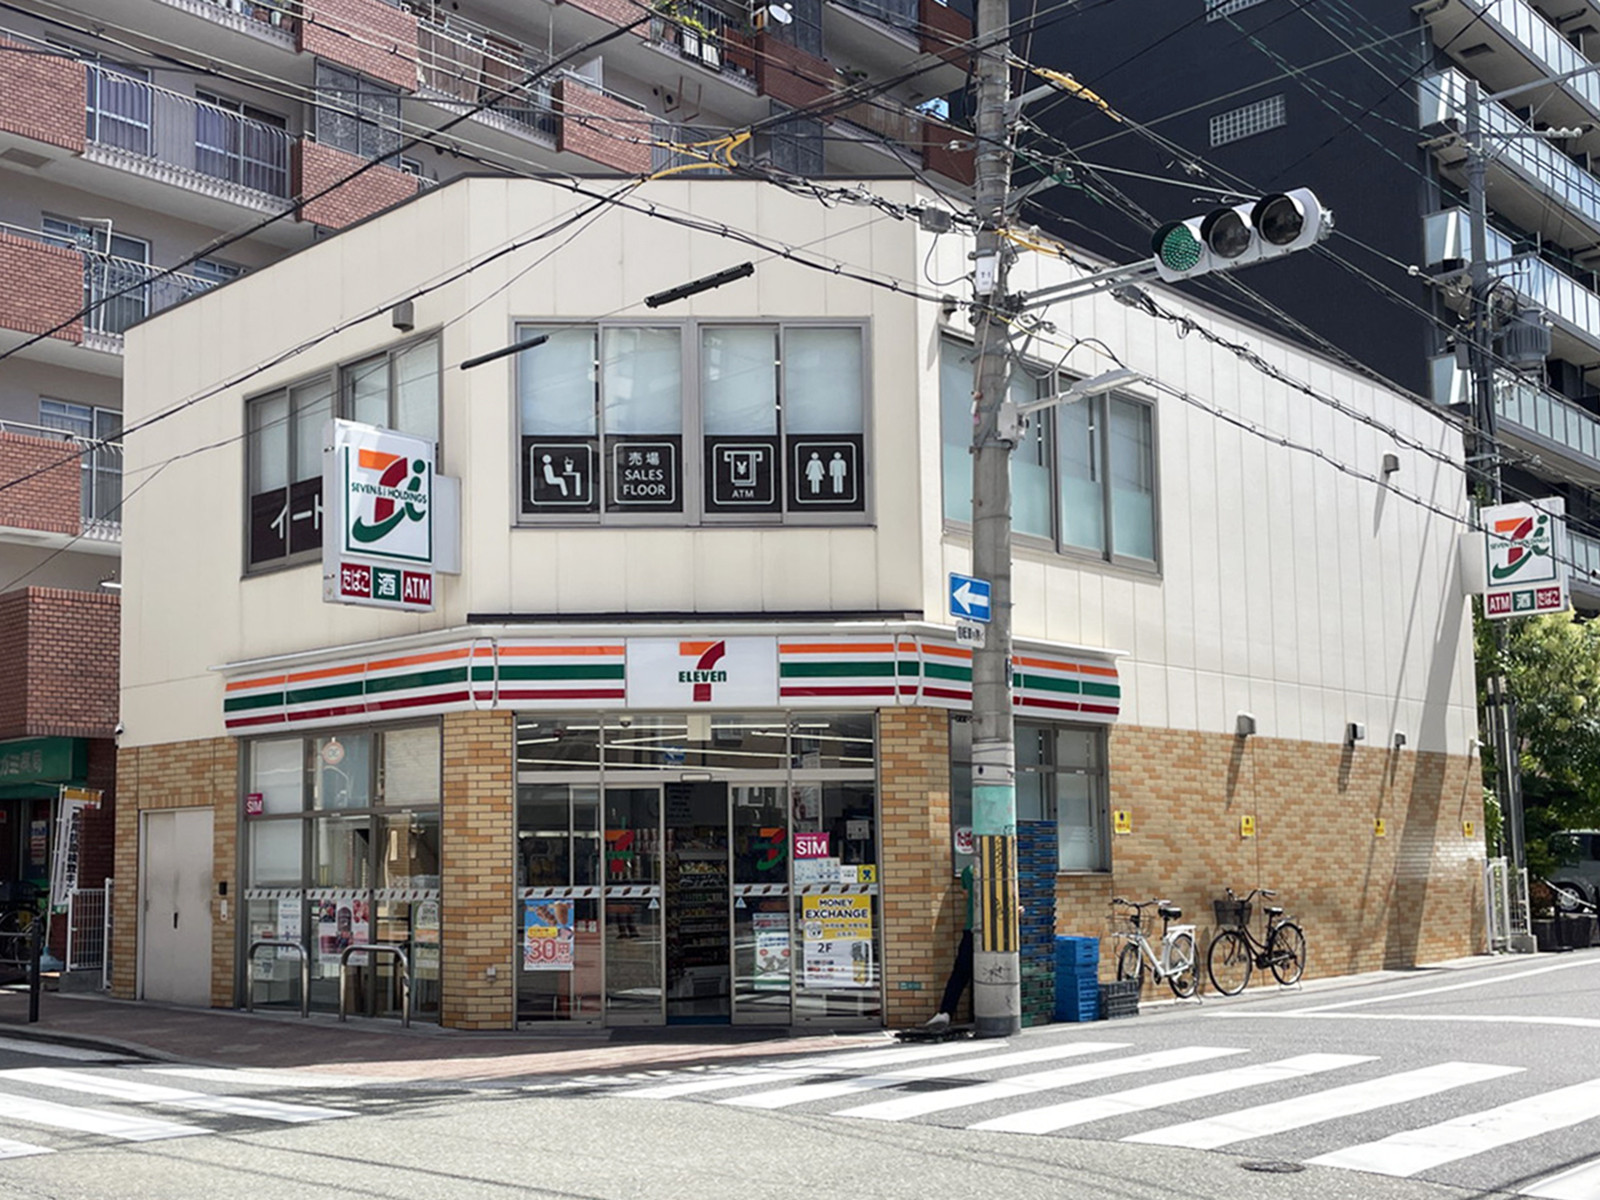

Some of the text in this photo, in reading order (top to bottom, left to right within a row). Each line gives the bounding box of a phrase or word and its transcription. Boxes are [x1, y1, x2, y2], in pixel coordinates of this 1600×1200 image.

[628, 452, 660, 466] 売場
[624, 469, 664, 481] SALES
[387, 488, 428, 504] HOLDINGS
[622, 483, 667, 496] FLOOR
[731, 489, 755, 499] ATM
[342, 568, 430, 600] たばこ 酒 ATM
[1489, 596, 1510, 612] ATM
[796, 840, 828, 855] SIM
[819, 899, 853, 907] MONEY
[805, 909, 868, 919] EXCHANGE
[817, 942, 832, 953] 2F
